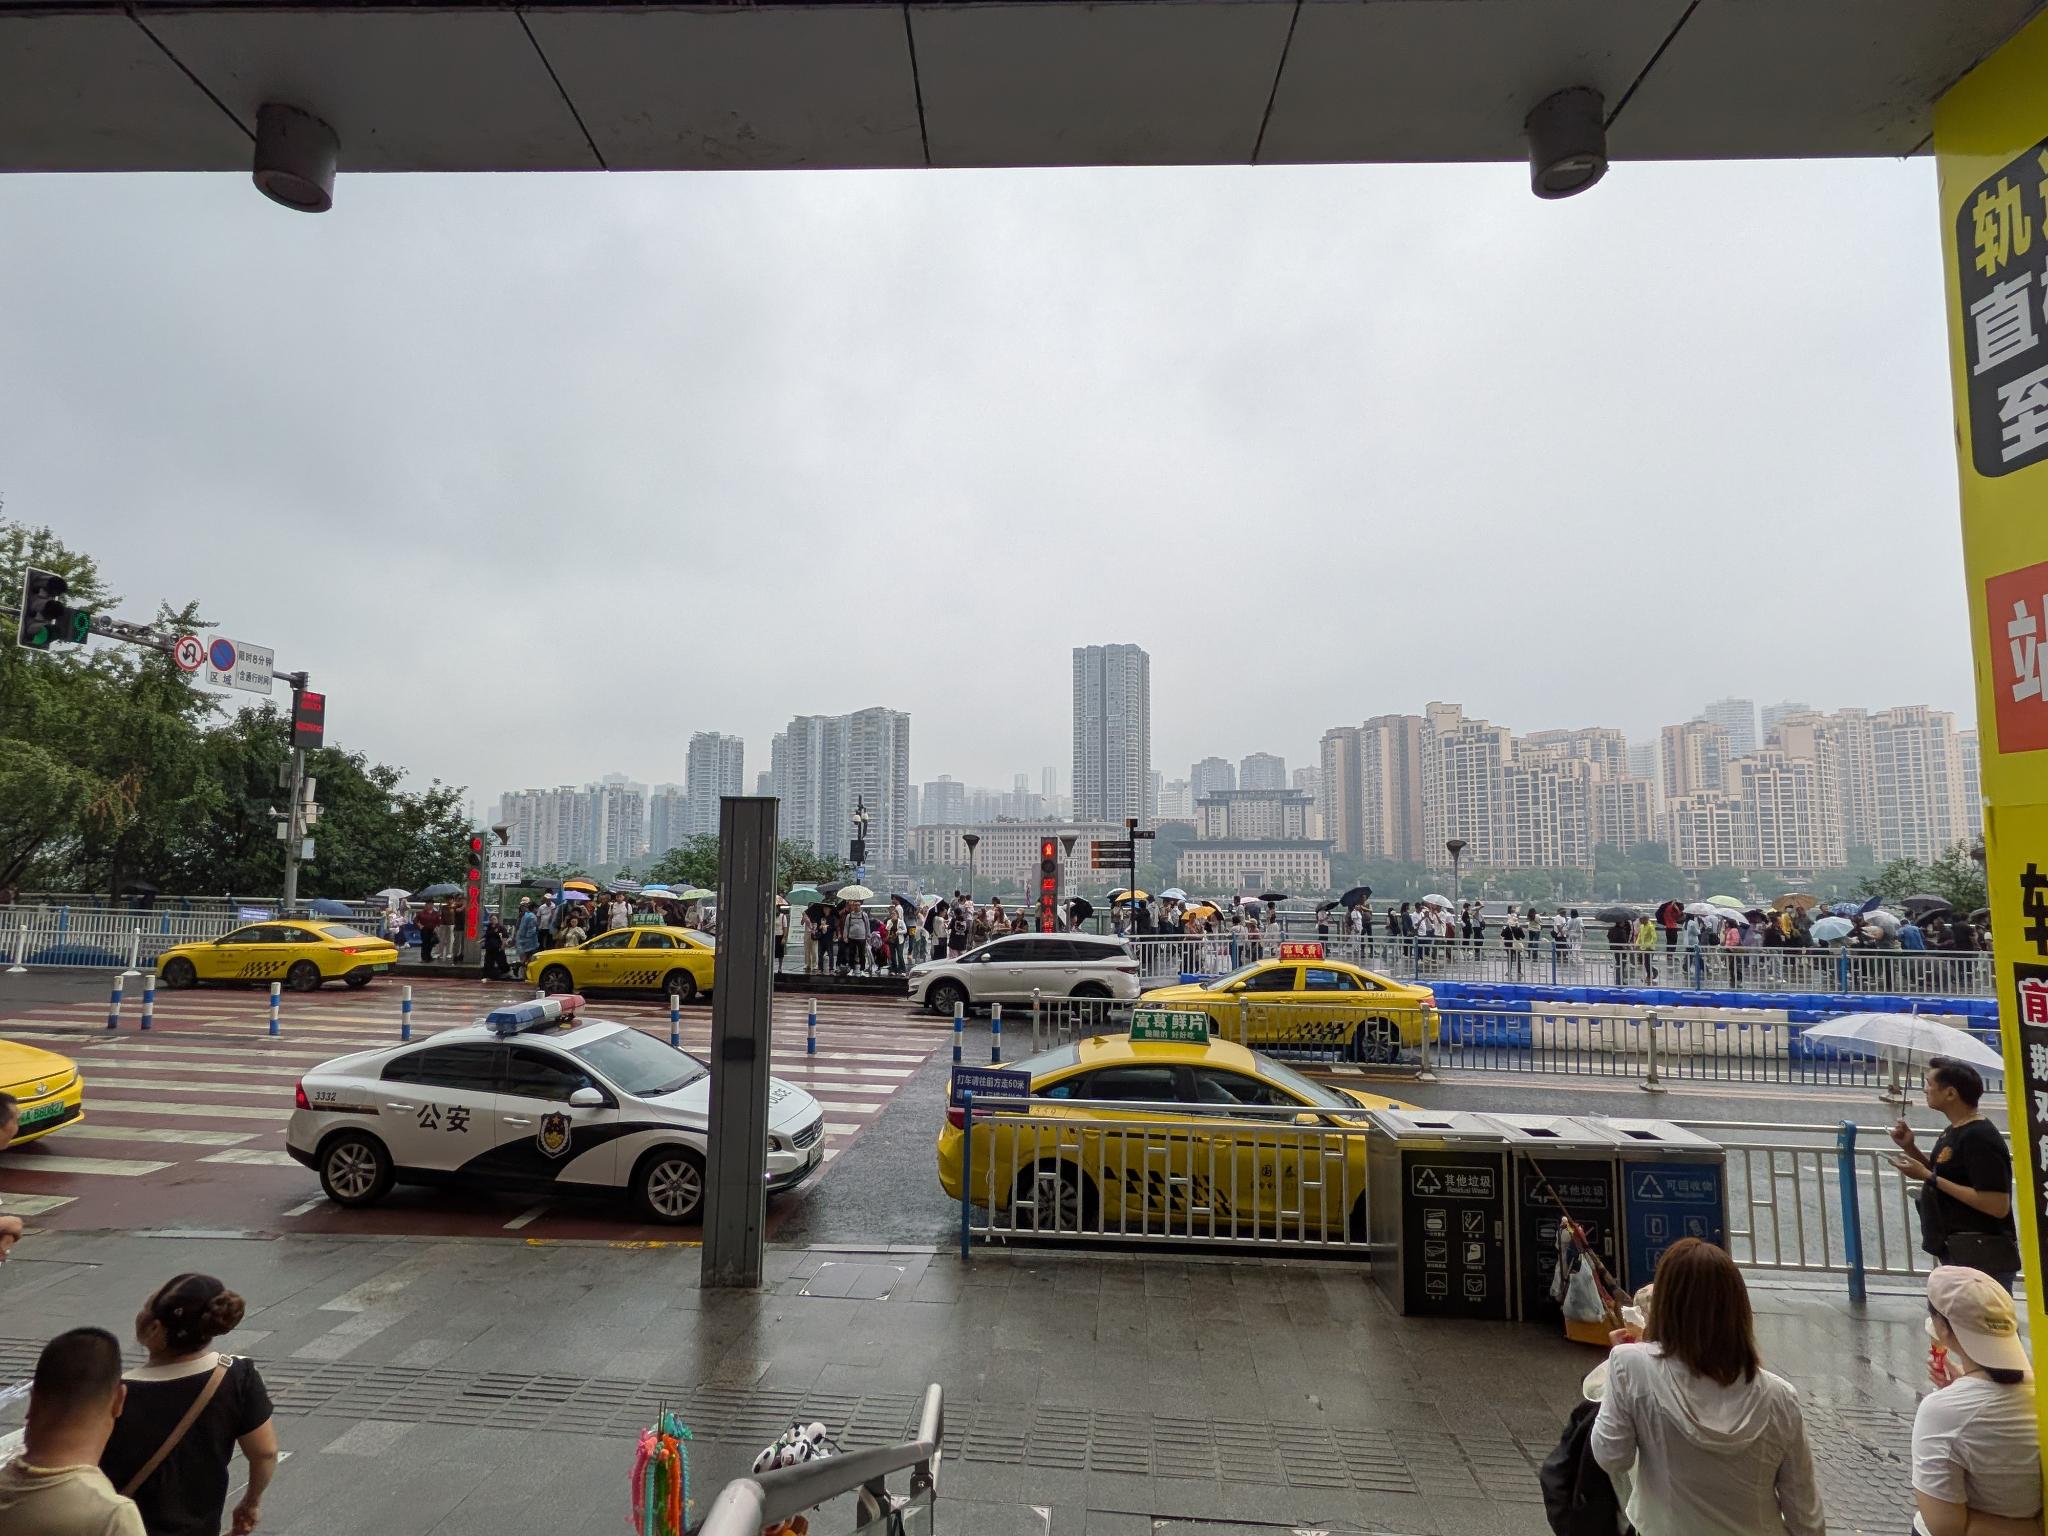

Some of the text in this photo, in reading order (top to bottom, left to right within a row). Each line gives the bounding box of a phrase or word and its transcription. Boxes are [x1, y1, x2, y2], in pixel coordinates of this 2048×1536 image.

[416, 1103, 471, 1134] 公安
[1444, 1173, 1492, 1188] 其他垃圾
